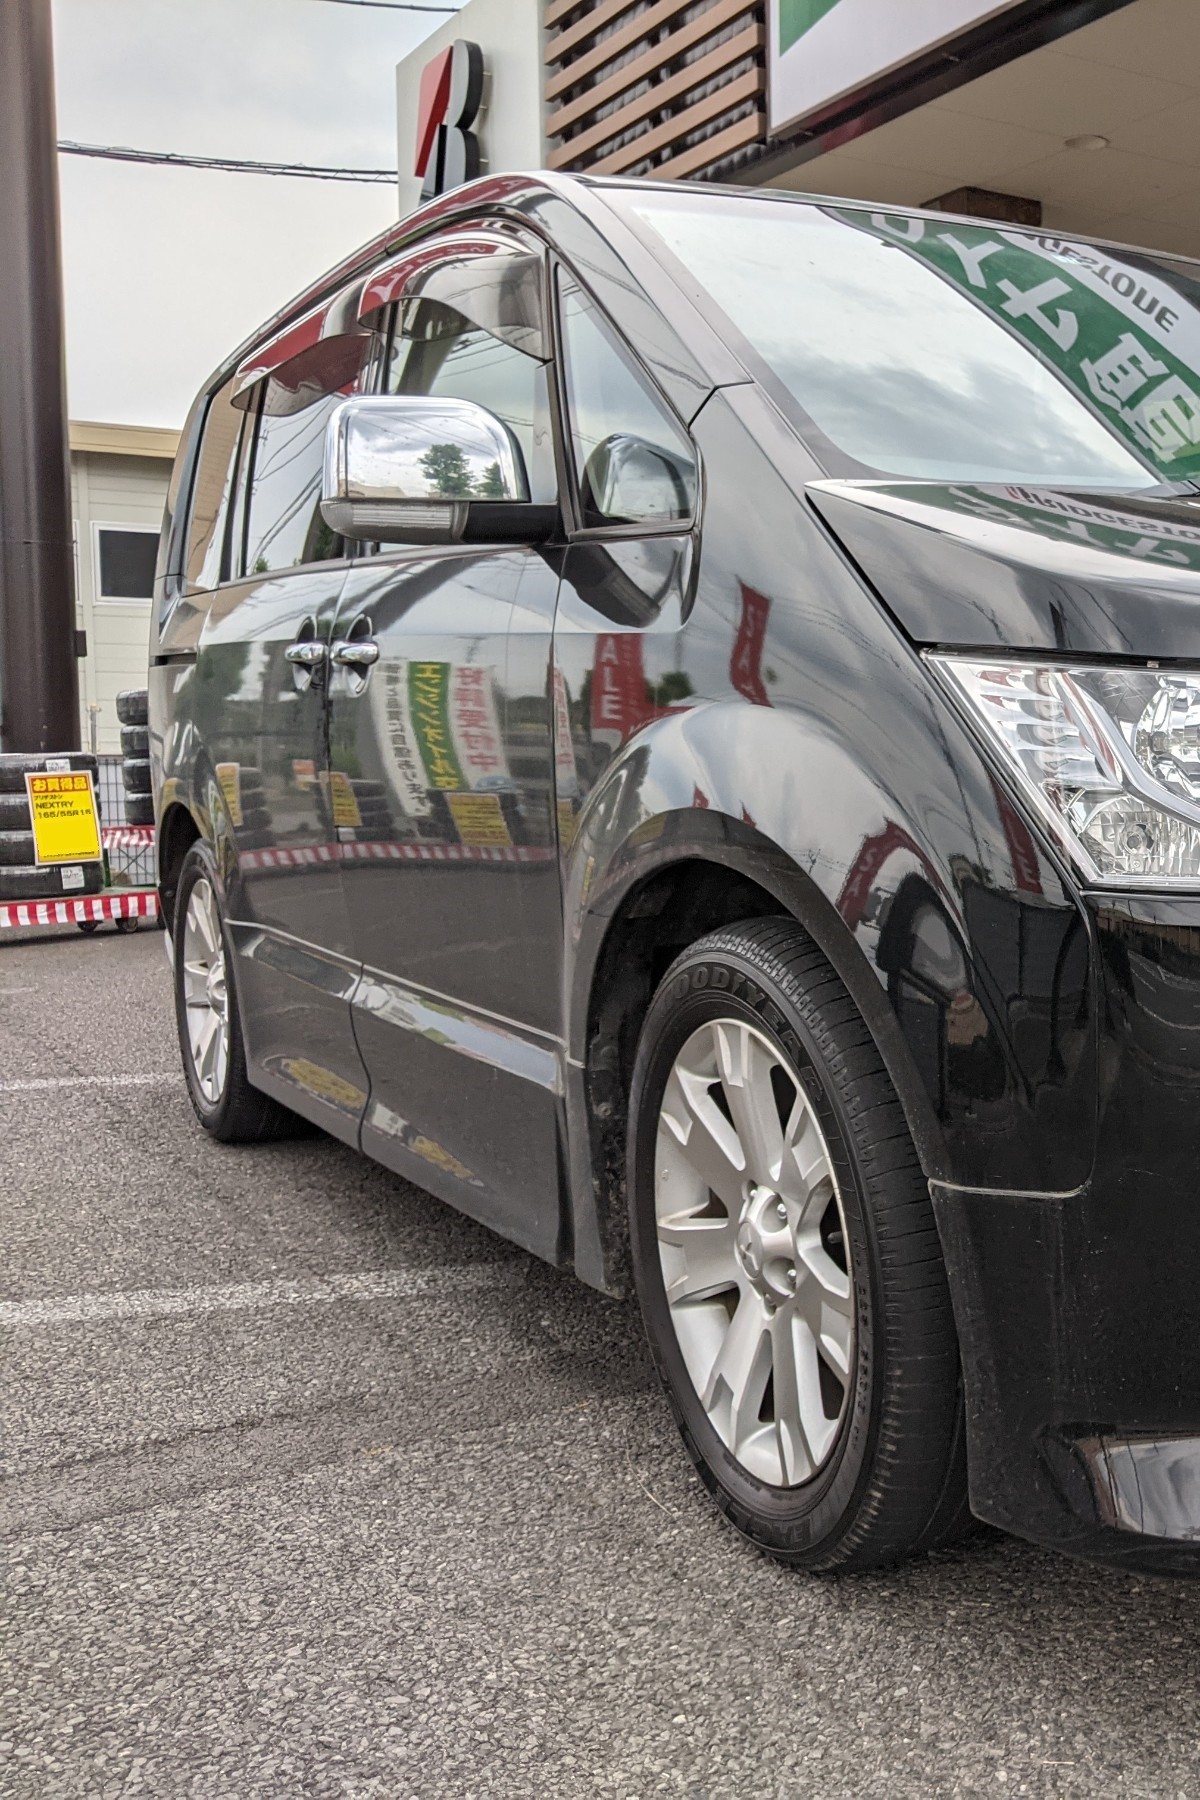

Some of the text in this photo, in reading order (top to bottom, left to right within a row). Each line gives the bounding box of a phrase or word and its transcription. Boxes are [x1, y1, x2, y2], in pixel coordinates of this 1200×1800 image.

[33, 776, 88, 792] お買得品
[35, 801, 74, 809] NEXTRY
